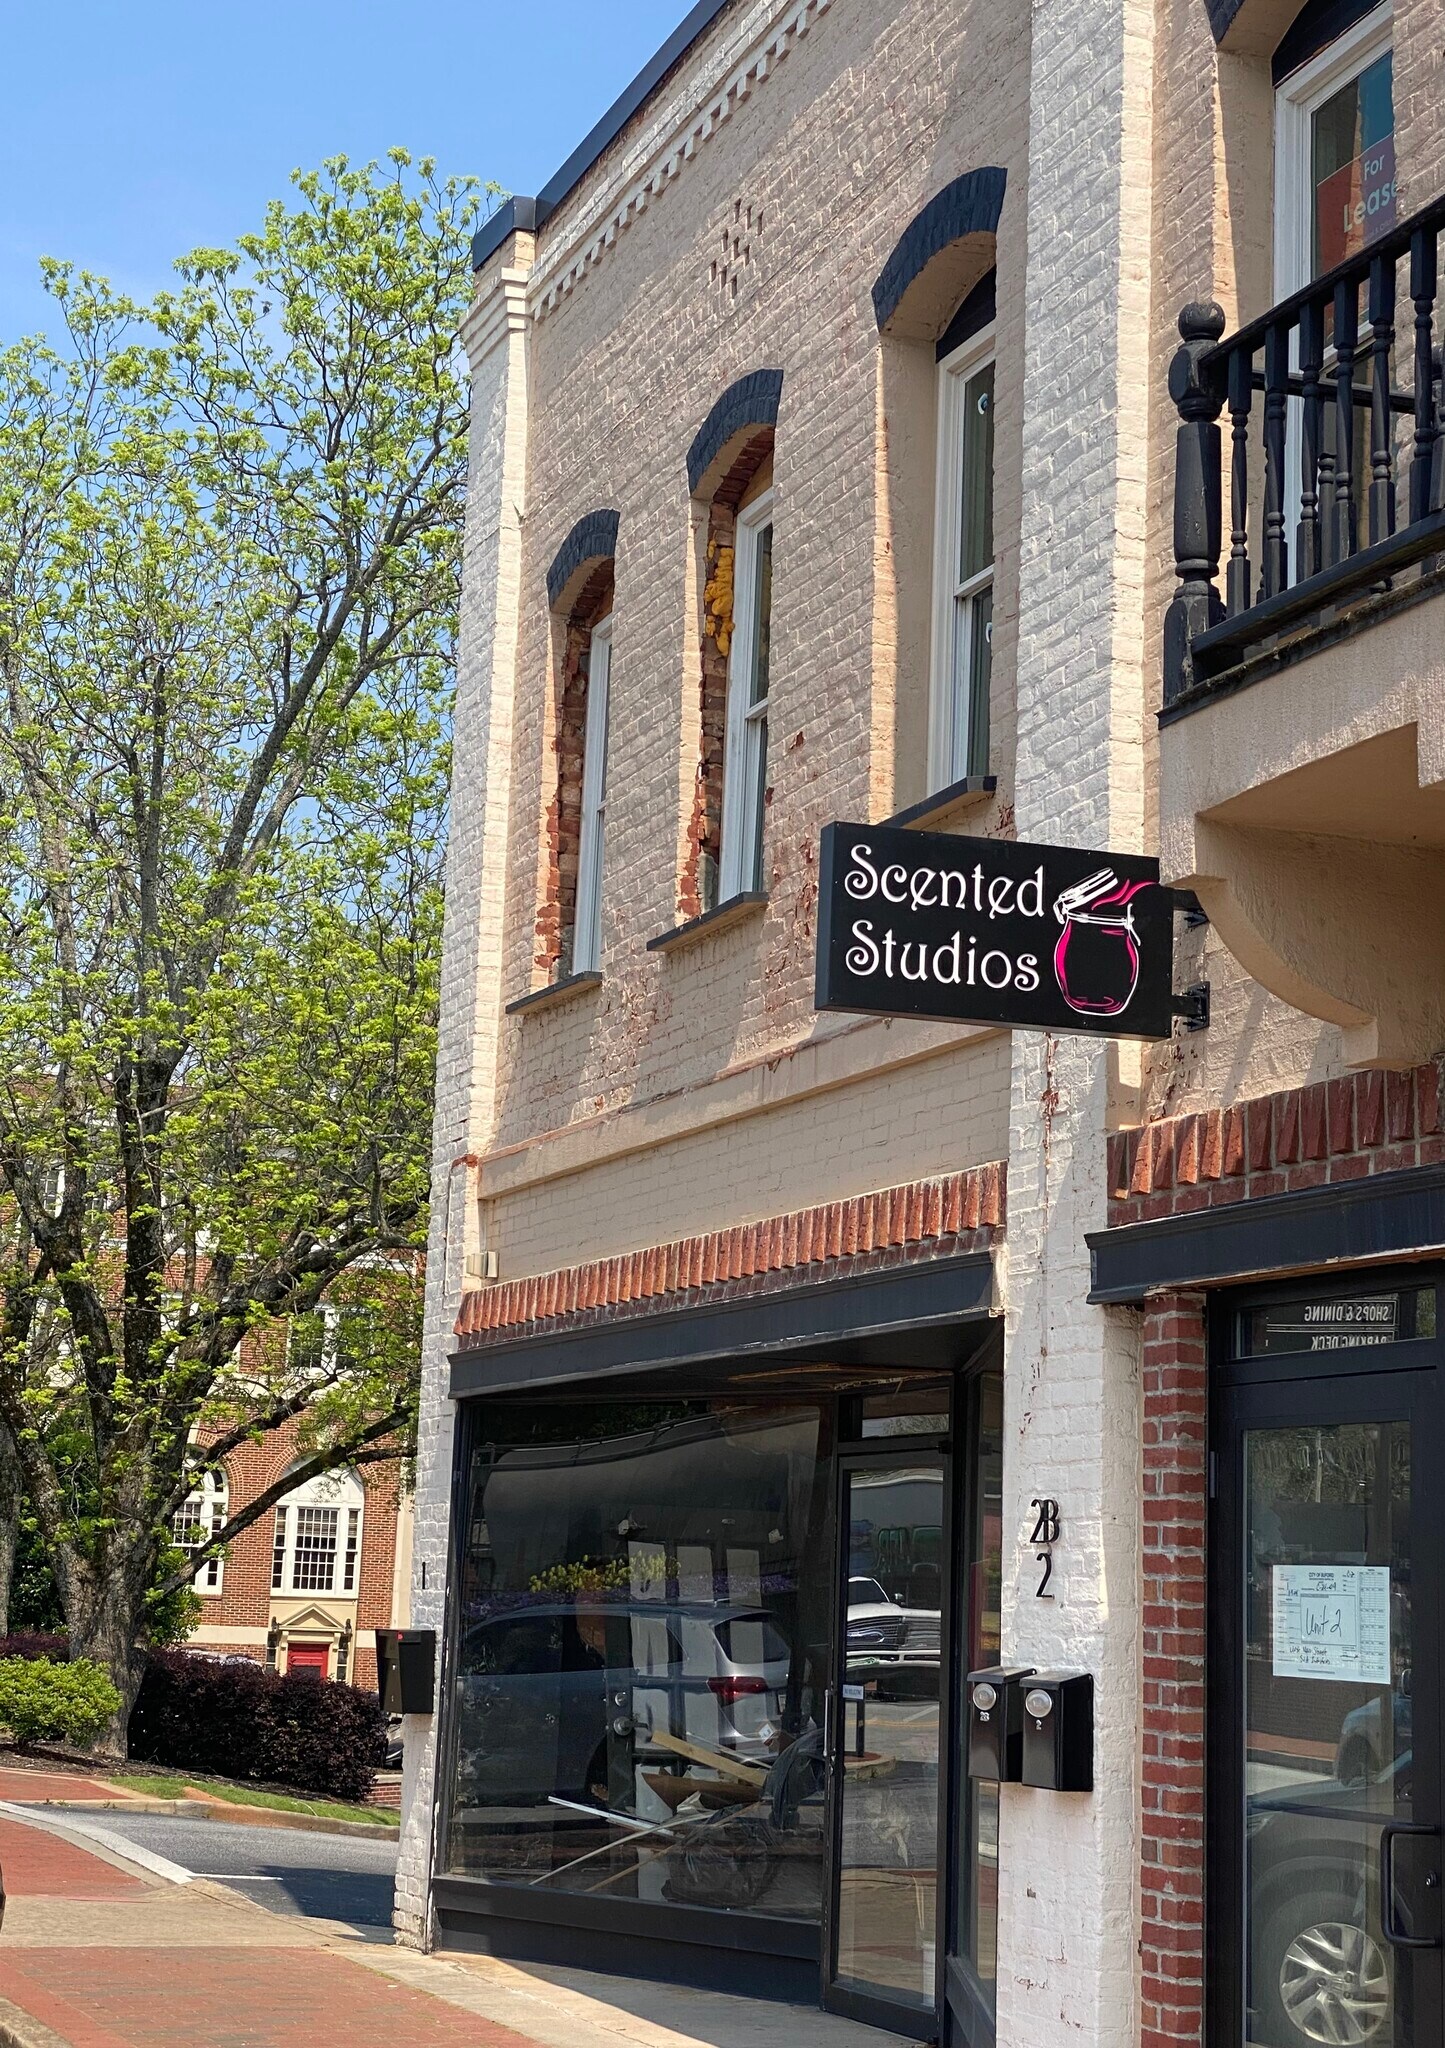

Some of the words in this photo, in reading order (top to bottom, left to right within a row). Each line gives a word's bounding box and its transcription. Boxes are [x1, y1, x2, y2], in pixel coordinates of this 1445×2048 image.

[1365, 155, 1385, 180] For
[844, 844, 1044, 919] Scented
[845, 919, 1040, 991] Studios
[1030, 1499, 1059, 1543] 2B
[1036, 1553, 1055, 1597] 2
[1306, 1605, 1329, 1636] Unit
[1330, 1608, 1342, 1637] 2
[1036, 1719, 1042, 1730] 2
